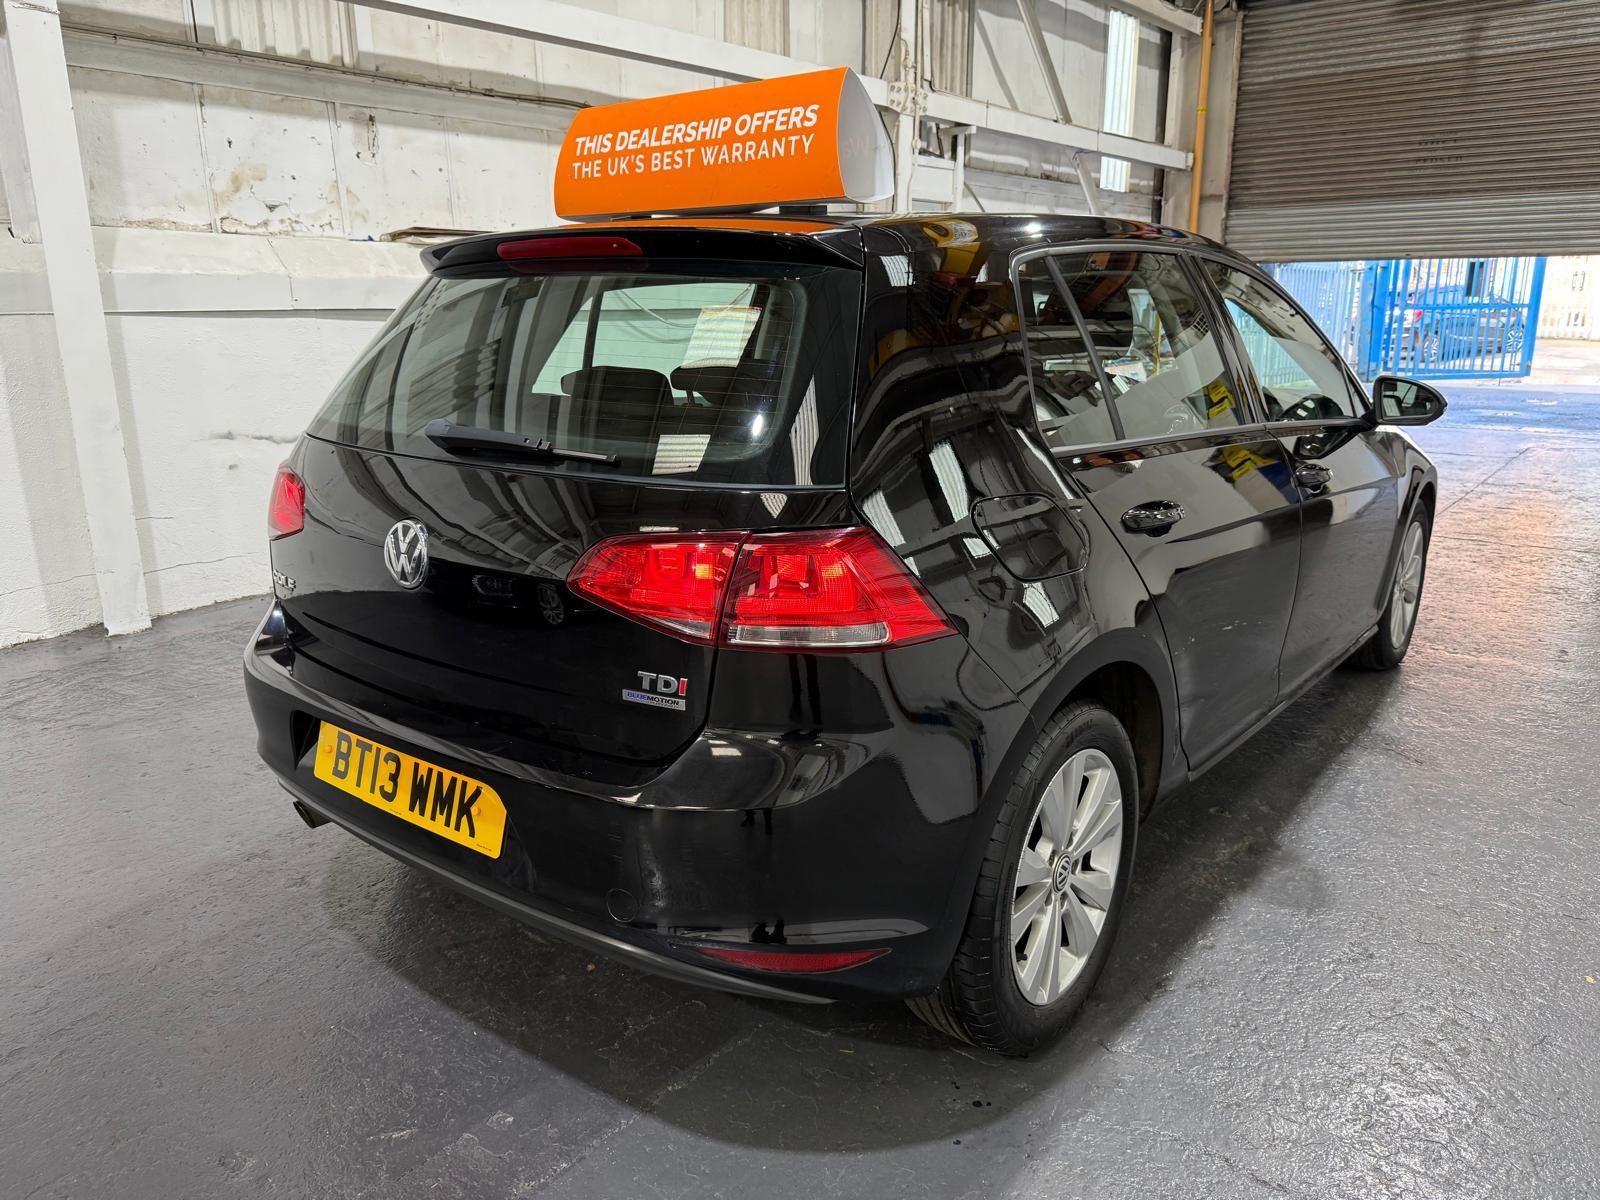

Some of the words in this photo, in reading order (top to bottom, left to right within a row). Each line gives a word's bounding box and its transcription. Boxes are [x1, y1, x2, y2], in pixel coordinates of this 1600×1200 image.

[575, 133, 613, 157] THIS
[615, 117, 732, 151] DEALERSHIP
[734, 104, 820, 136] OFFERS
[572, 160, 602, 180] THE
[607, 153, 646, 176] UK'S
[651, 148, 695, 172] BEST
[700, 133, 815, 167] WARRANTY
[627, 691, 680, 706] BLUEMOTION
[637, 670, 689, 696] TDI
[332, 730, 402, 803] BT13
[408, 761, 484, 839] WMK
